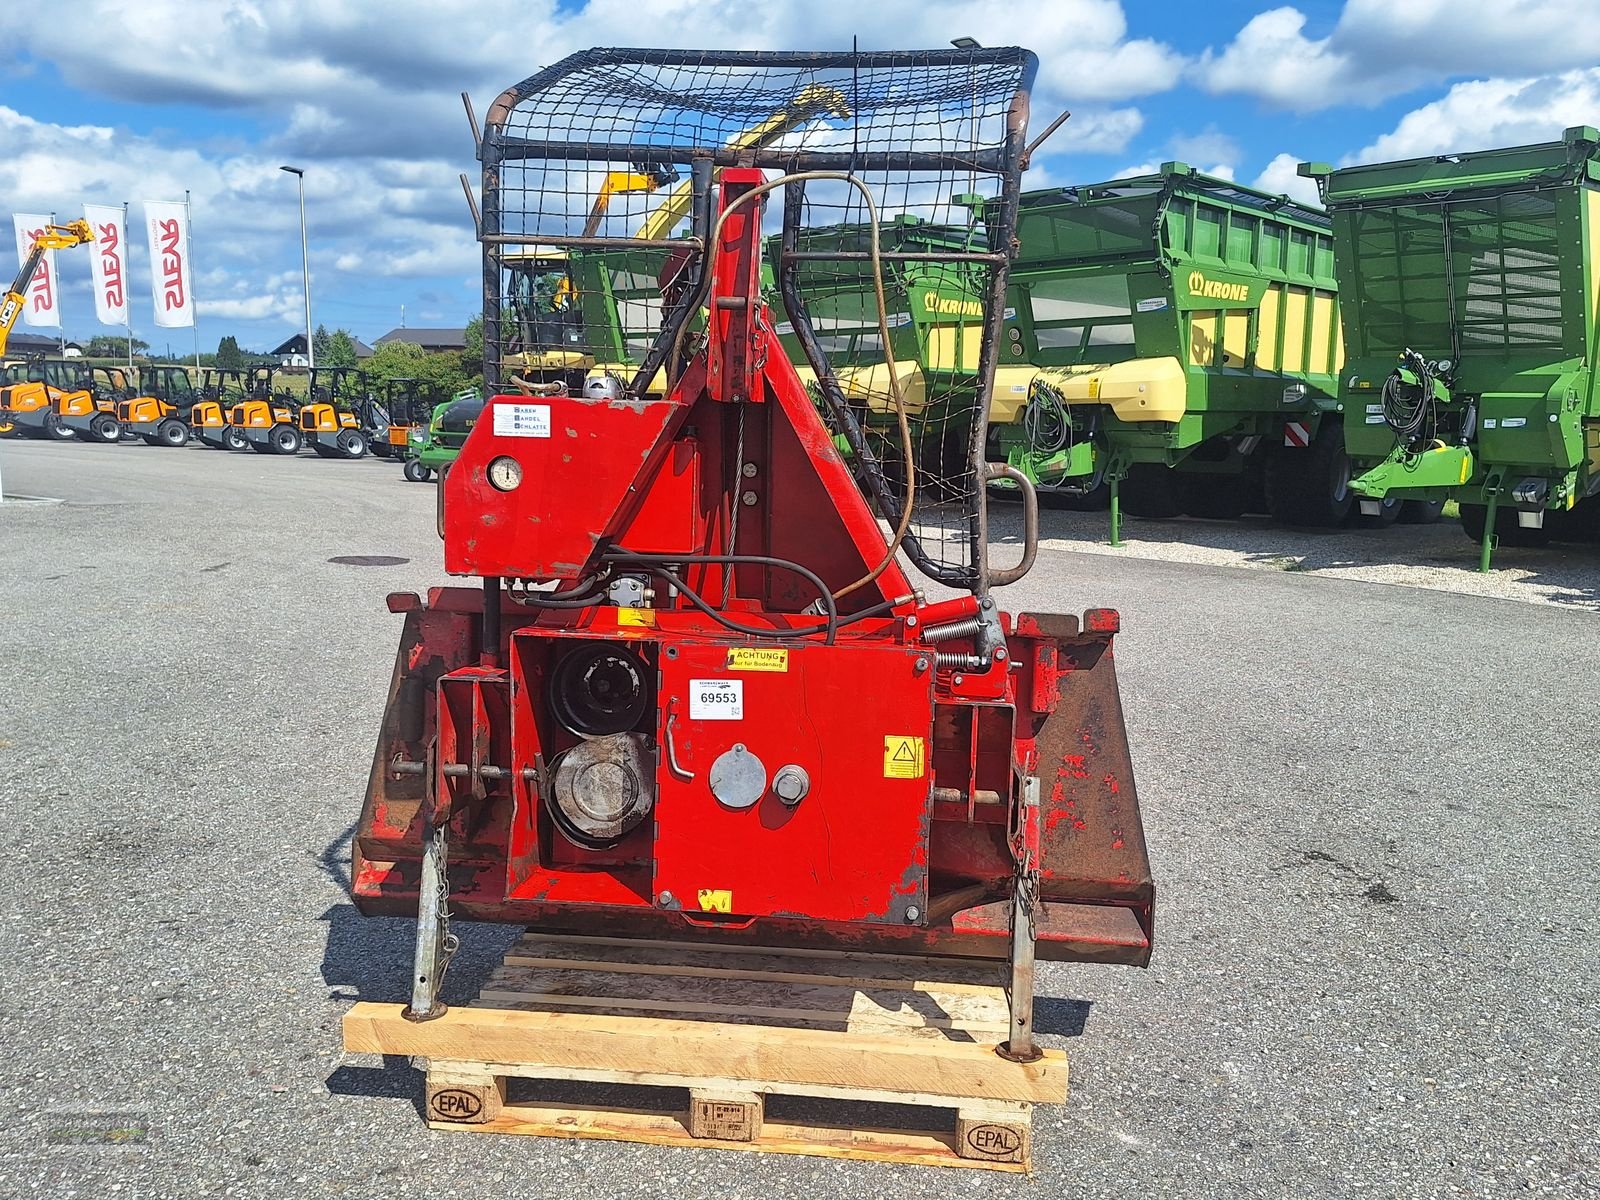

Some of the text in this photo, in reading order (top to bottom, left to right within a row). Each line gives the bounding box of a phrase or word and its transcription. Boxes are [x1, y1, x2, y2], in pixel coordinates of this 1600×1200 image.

[1203, 280, 1249, 302] KRONE
[0, 300, 17, 328] JCB
[736, 651, 779, 660] ACHTUNG
[701, 692, 737, 703] 69553
[439, 1095, 475, 1113] EPAL
[976, 1130, 1012, 1150] EPAL
